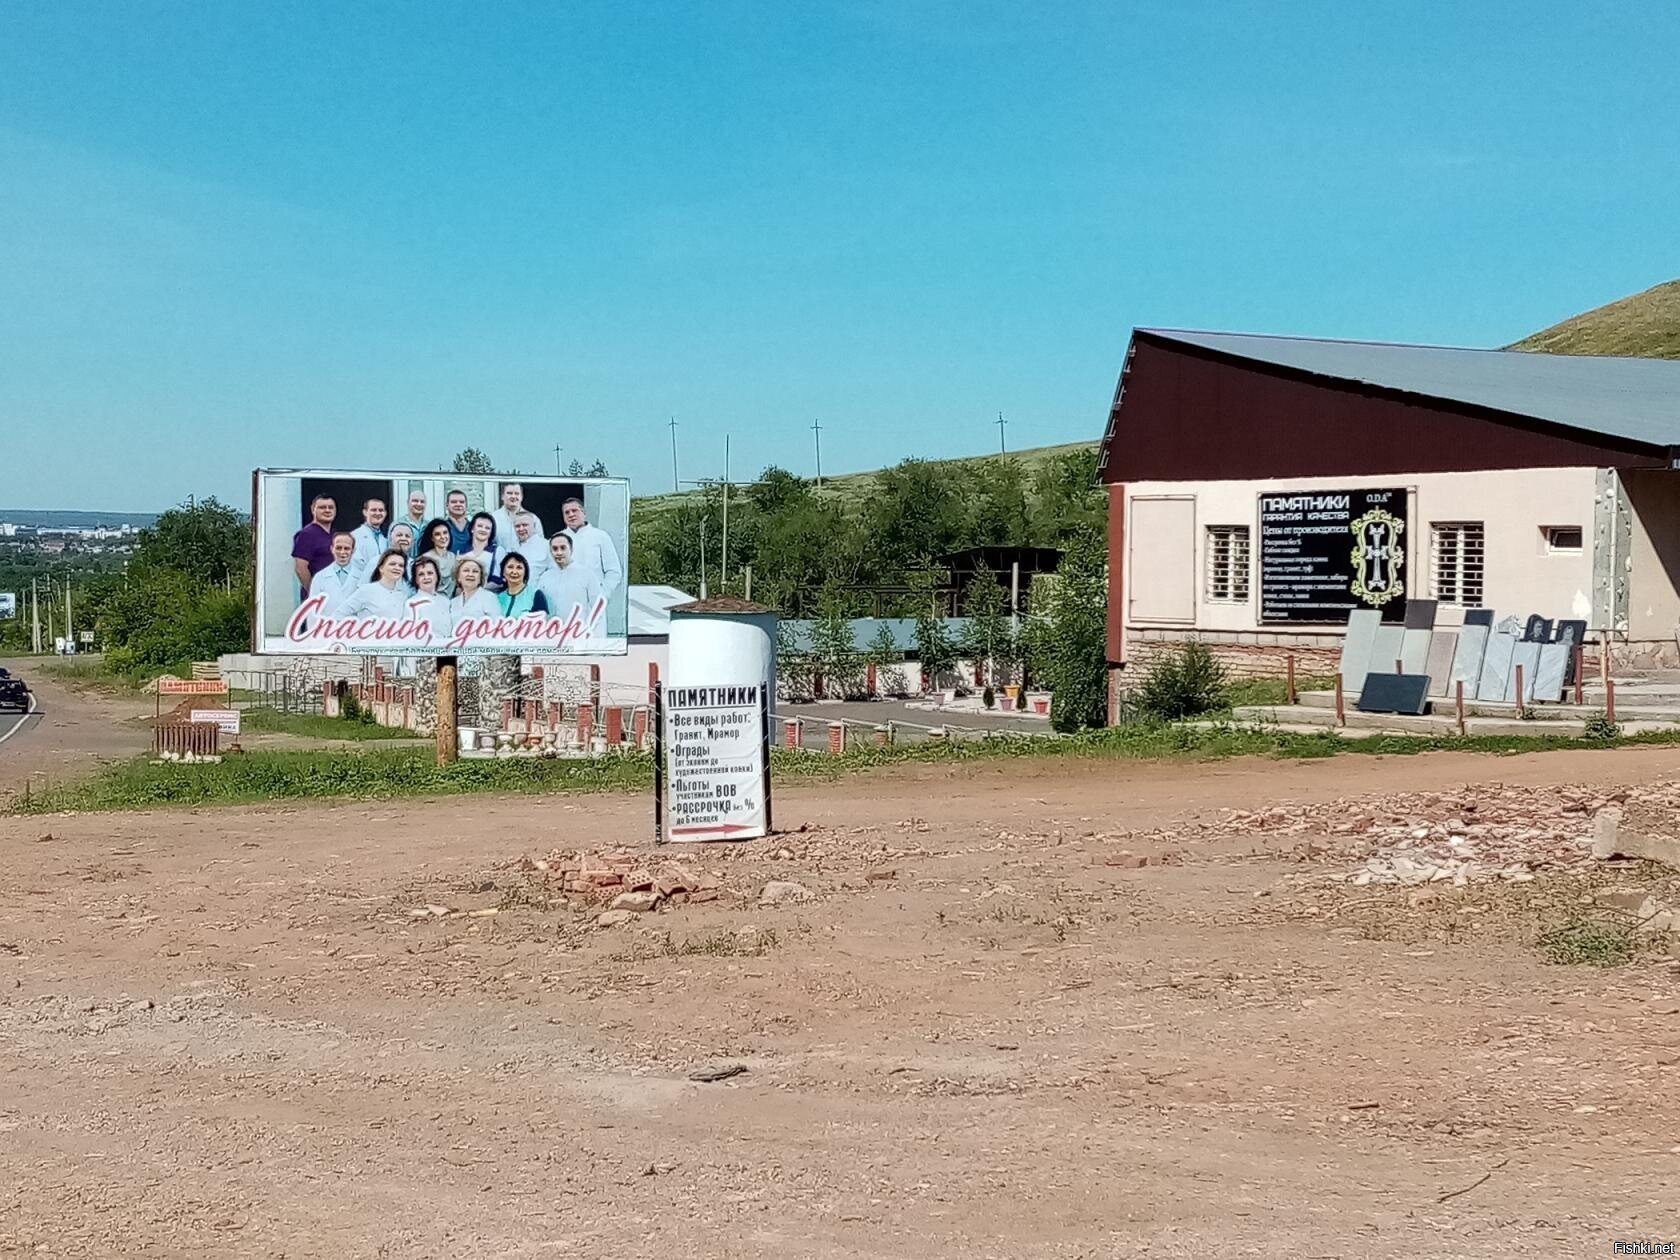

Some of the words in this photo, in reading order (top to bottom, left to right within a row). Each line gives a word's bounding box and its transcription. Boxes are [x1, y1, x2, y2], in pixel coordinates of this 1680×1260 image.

[1263, 495, 1350, 511] ПАМЯТНИКИ
[1263, 512, 1303, 521] ГАРАНТИЯ
[1307, 511, 1350, 520] КАЧЕСТВА
[289, 595, 433, 646] Спасибо,
[446, 598, 604, 649] доктор!
[668, 687, 757, 707] ПАМЯТНИКИ
[674, 713, 692, 727] Все
[694, 715, 719, 727] виды
[707, 728, 740, 740] Мрамор
[675, 744, 710, 759] Ограды
[710, 758, 719, 766] до
[676, 779, 710, 792] Льготы
[676, 791, 713, 800] участникам
[716, 784, 737, 797] ВОВ
[676, 800, 731, 814] РАССРОЧКА
[676, 817, 684, 825] до
